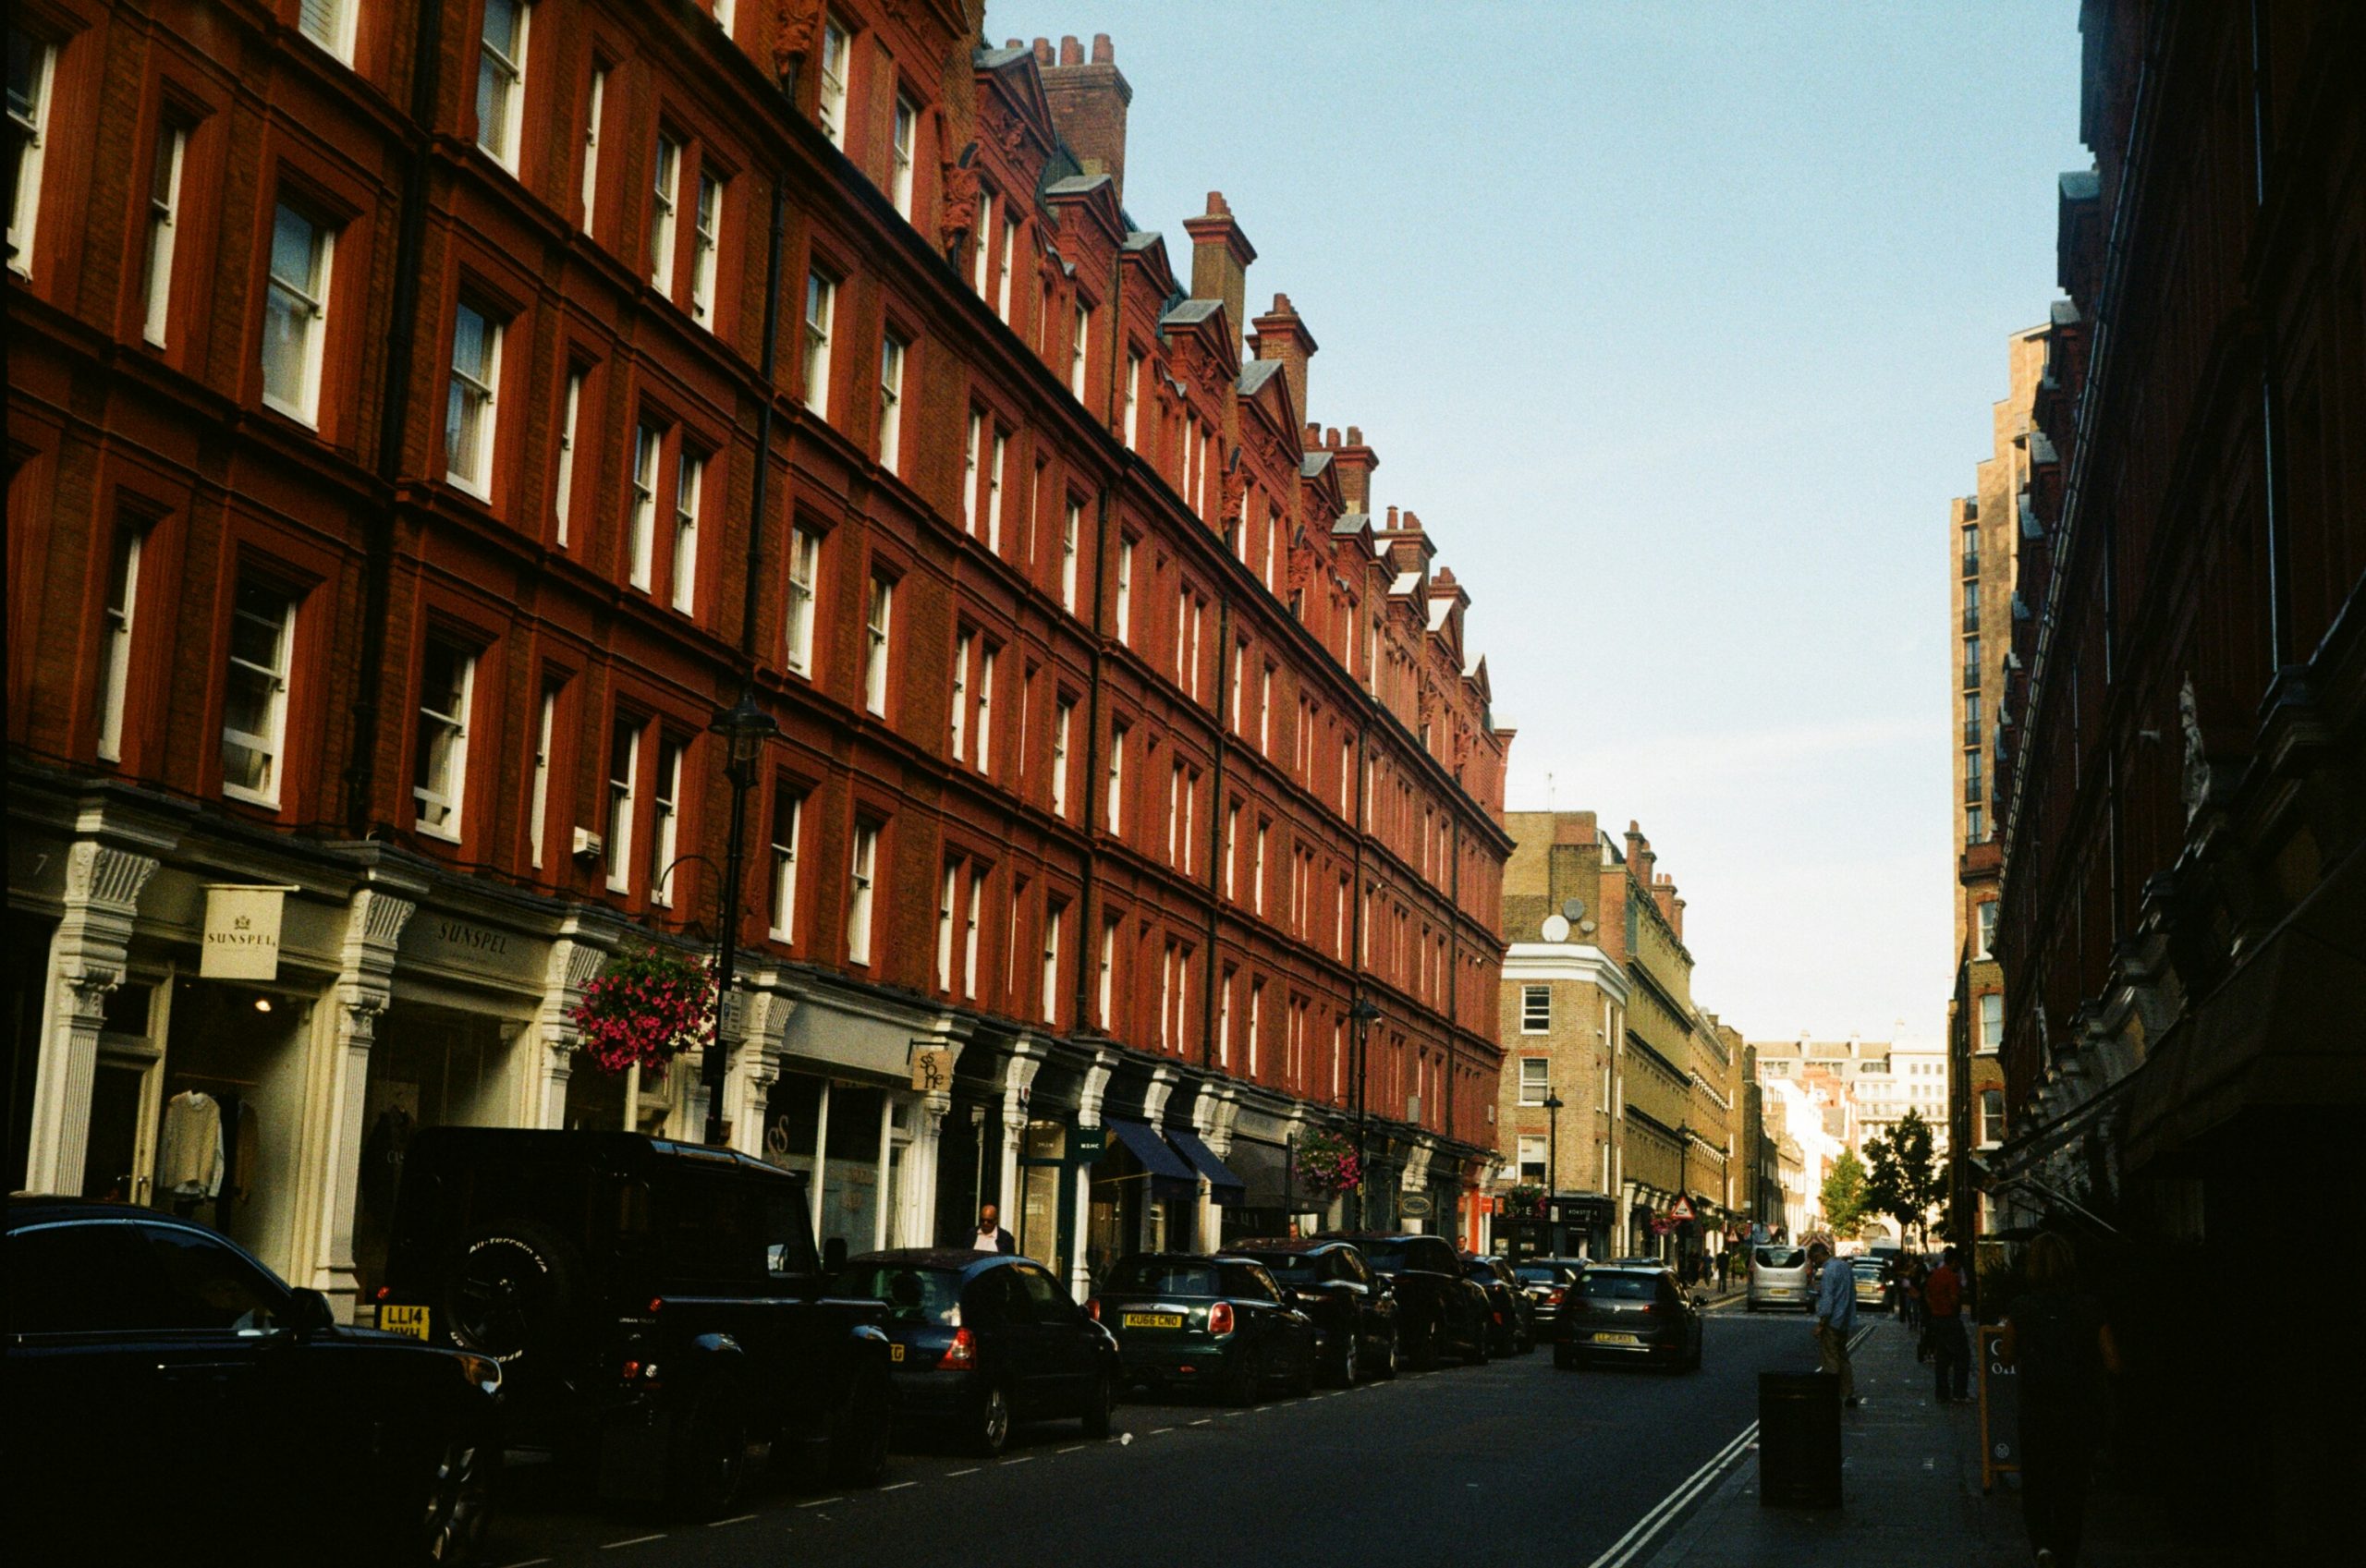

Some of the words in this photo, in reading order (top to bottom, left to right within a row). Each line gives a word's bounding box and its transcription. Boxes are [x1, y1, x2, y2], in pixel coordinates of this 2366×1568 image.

[208, 932, 276, 947] SUNSPEL
[438, 923, 506, 954] SUNSPEL
[388, 1307, 423, 1324] LL14
[1129, 1314, 1156, 1326] KU66
